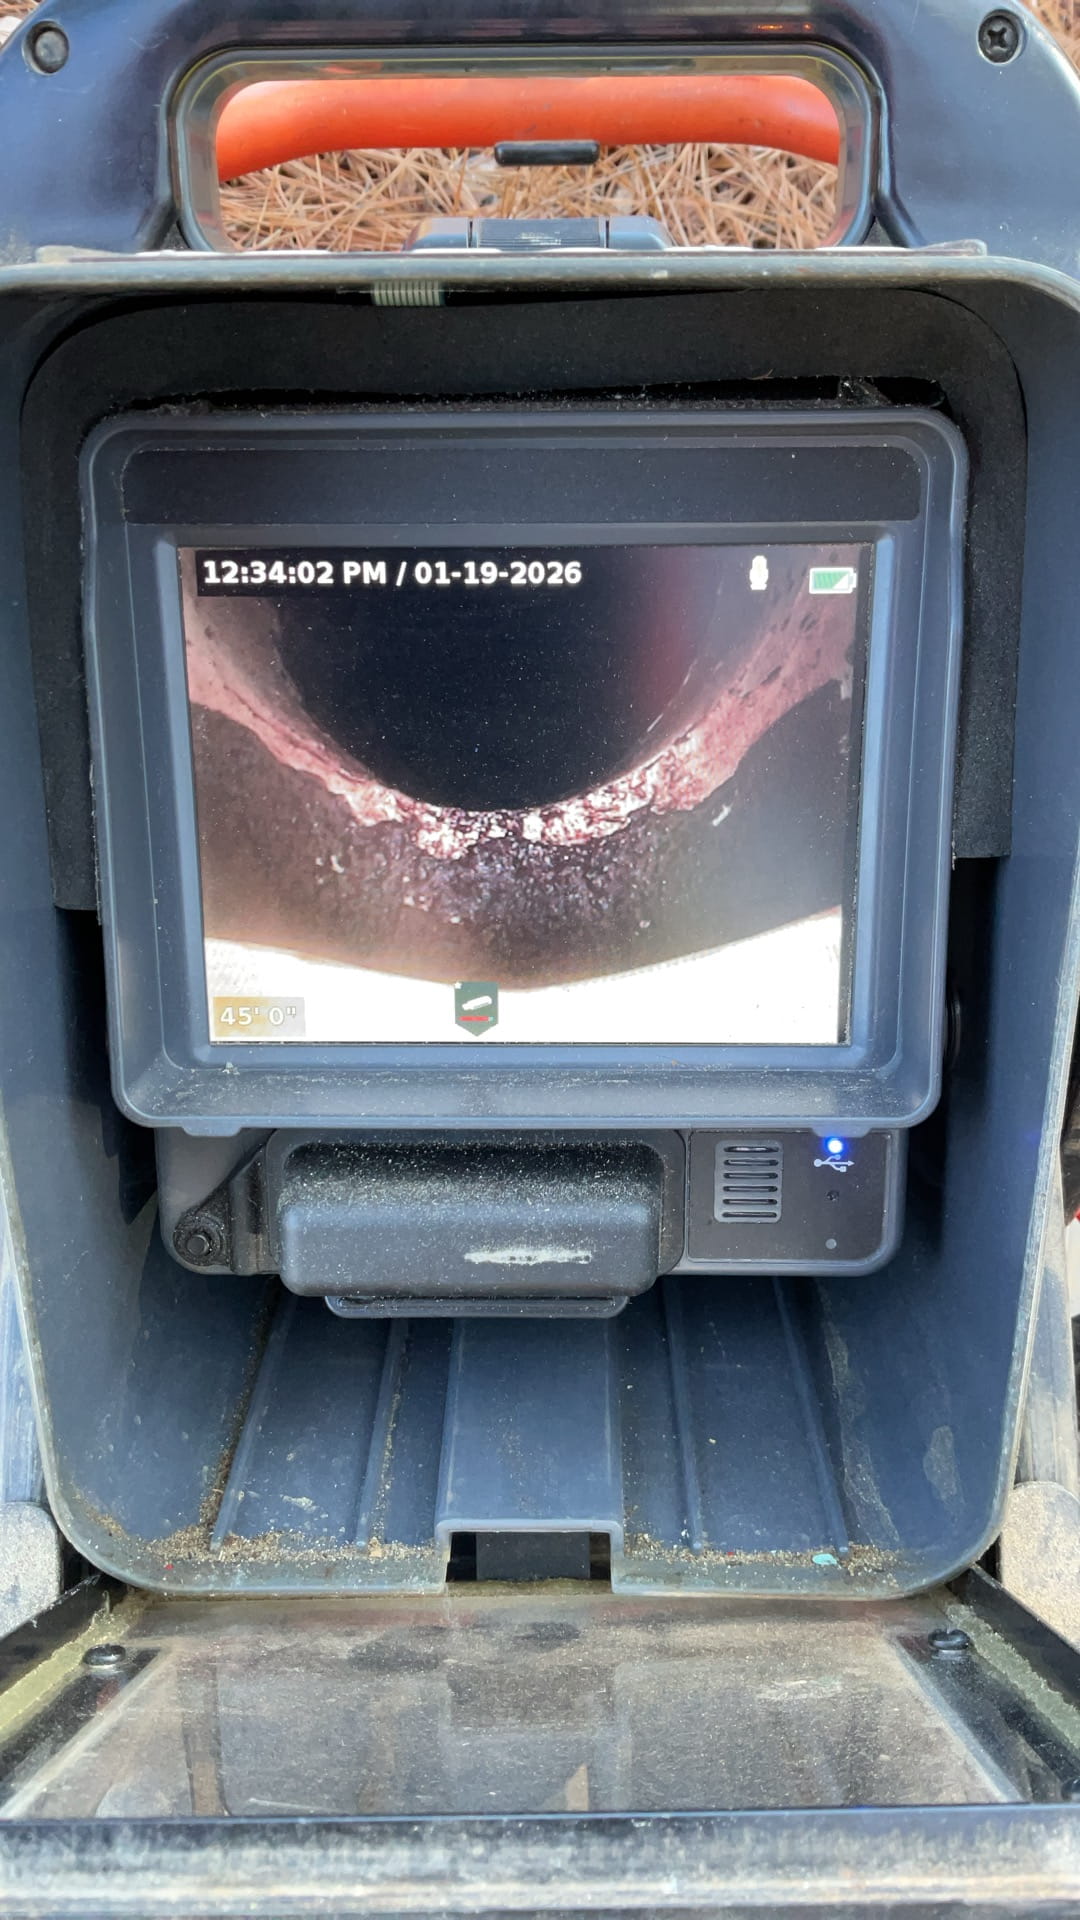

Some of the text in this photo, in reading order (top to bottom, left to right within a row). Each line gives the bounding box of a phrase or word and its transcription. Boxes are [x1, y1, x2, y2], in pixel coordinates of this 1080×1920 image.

[203, 560, 583, 587] 12:34:02 PM / 01-19-2026
[219, 1006, 260, 1026] 45'
